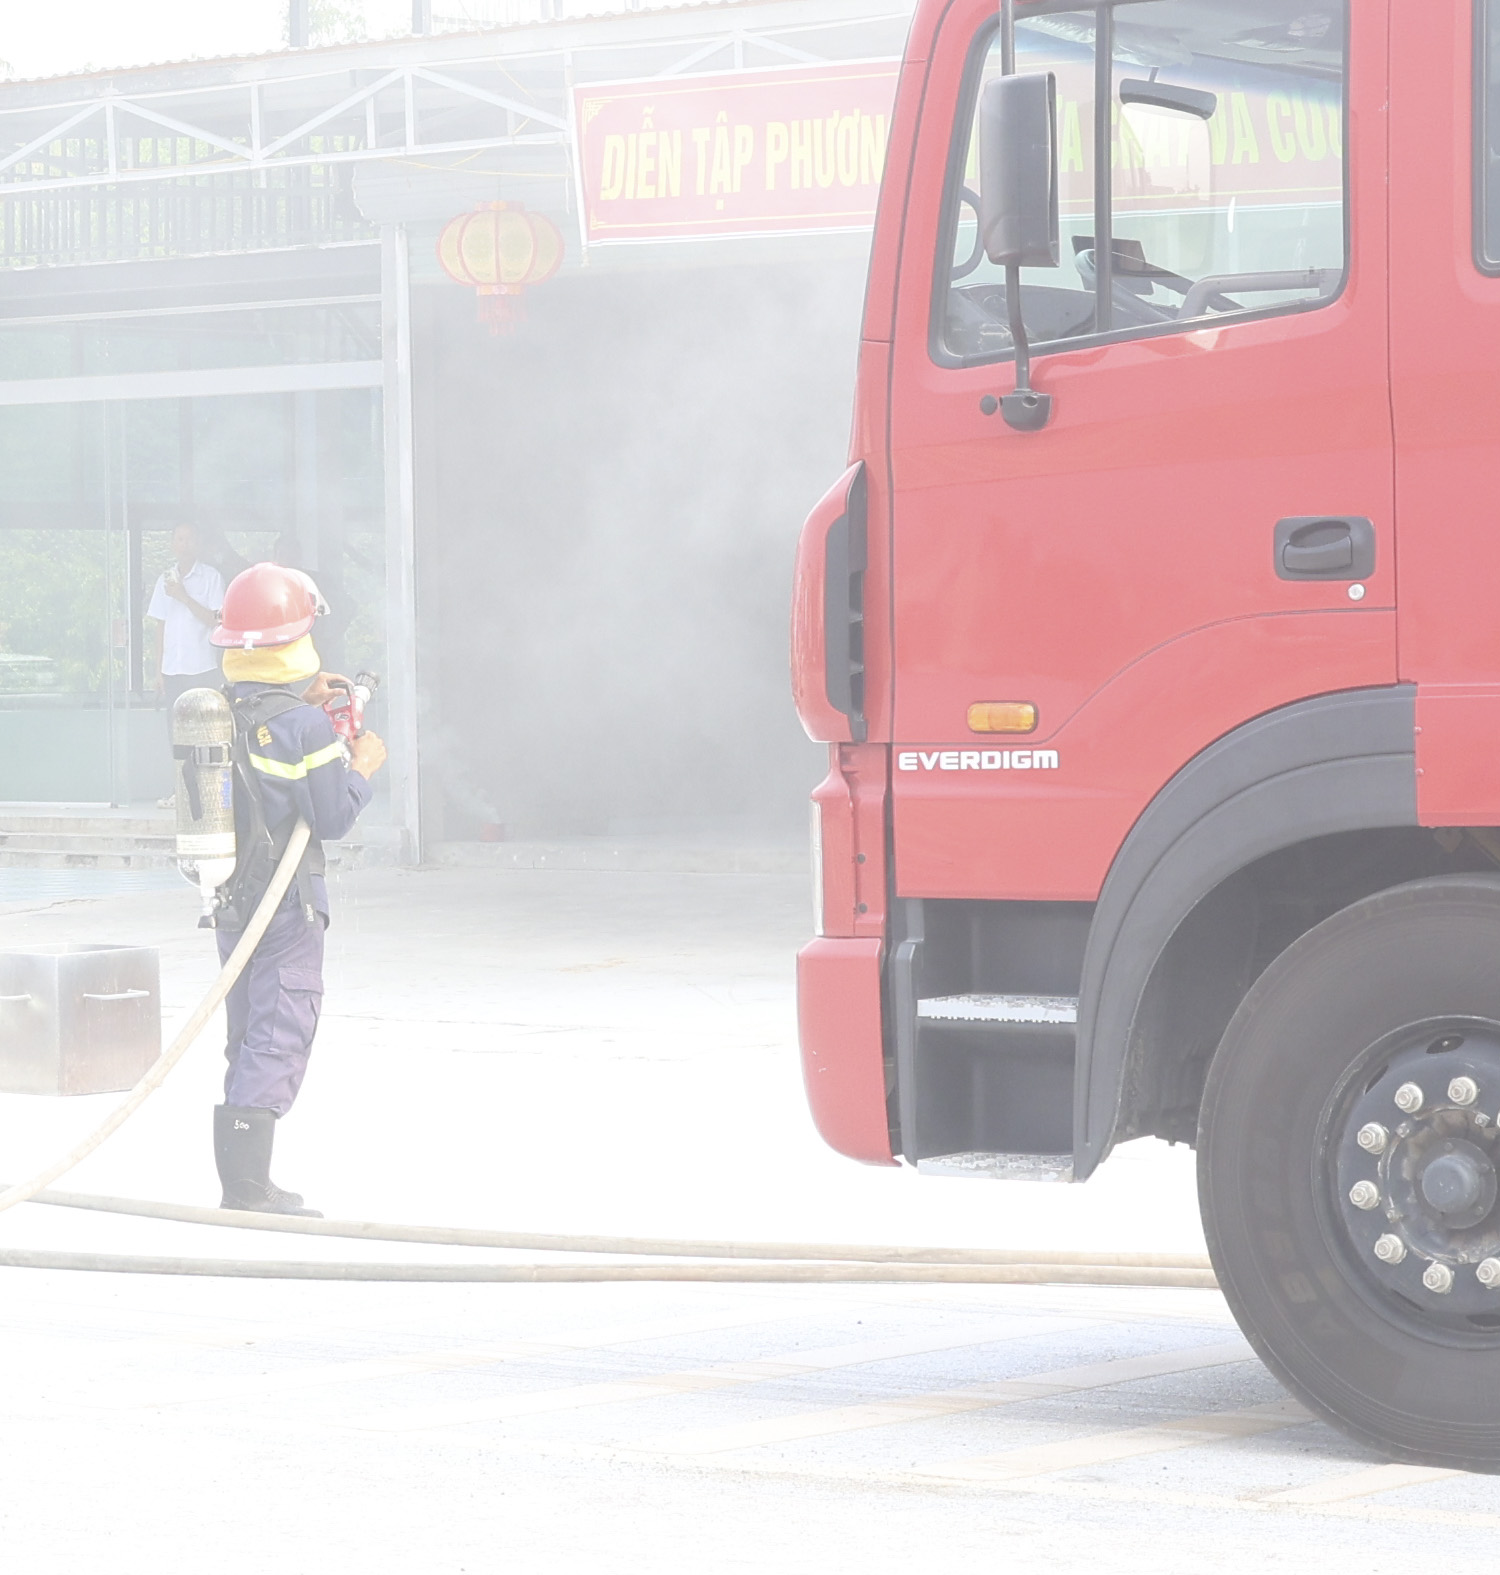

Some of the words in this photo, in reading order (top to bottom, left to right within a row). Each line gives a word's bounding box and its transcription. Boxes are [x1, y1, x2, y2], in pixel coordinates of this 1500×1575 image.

[599, 106, 683, 201] DIỄN
[692, 110, 754, 211] TẬP
[765, 108, 886, 191] PHƯƠN
[898, 749, 1059, 771] EVERDIGM
